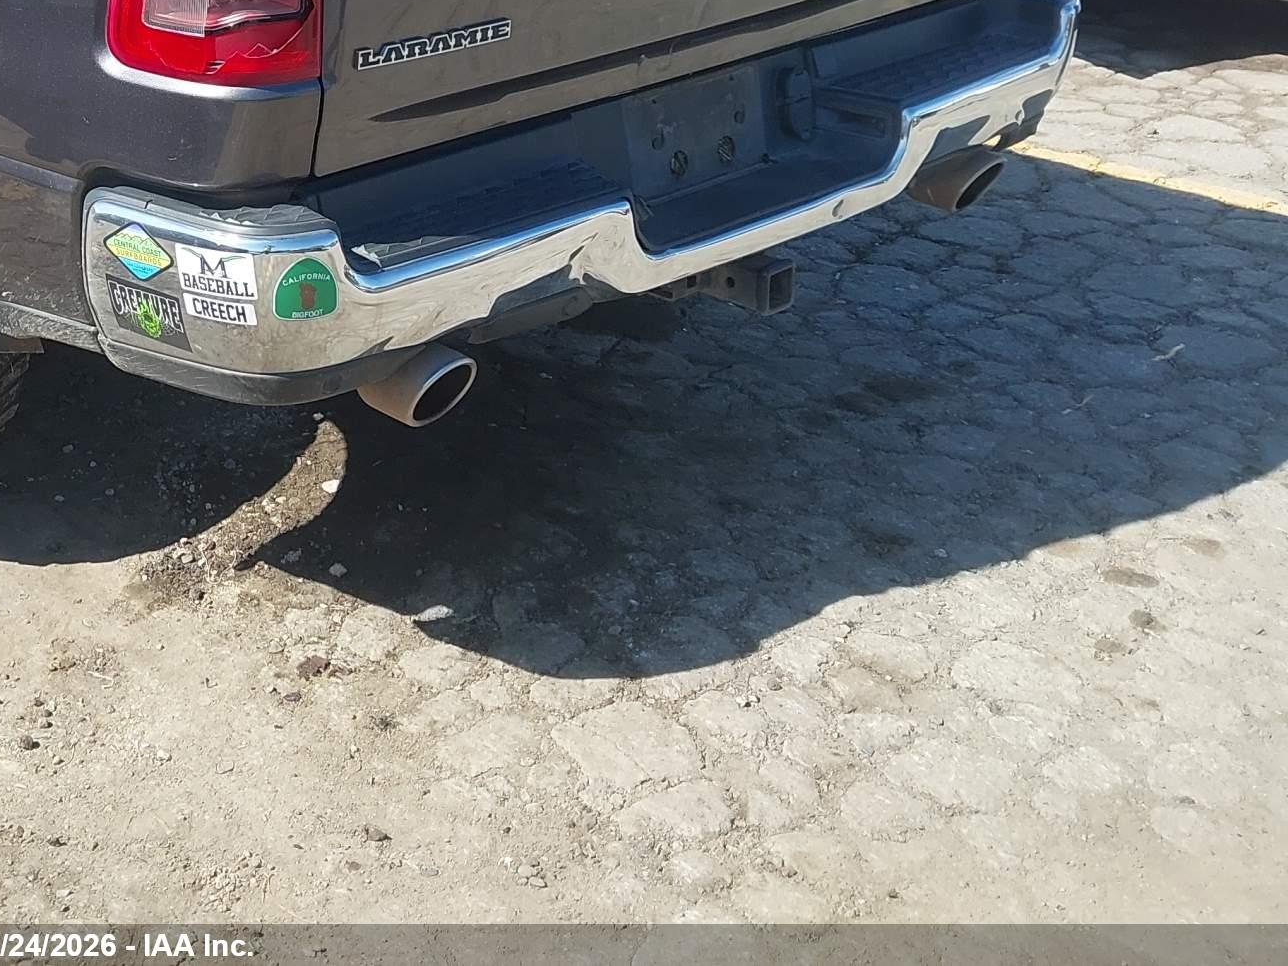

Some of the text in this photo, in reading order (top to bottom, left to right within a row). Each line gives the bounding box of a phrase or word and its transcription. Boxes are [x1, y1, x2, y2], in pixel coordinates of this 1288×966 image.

[355, 17, 512, 71] LARAMIE
[113, 238, 162, 258] CENTRAL COAST
[181, 272, 255, 298] BASEBALL
[282, 272, 331, 287] CALIFORNIA
[192, 297, 248, 323] CREECH
[291, 308, 324, 319] BIGFOOT
